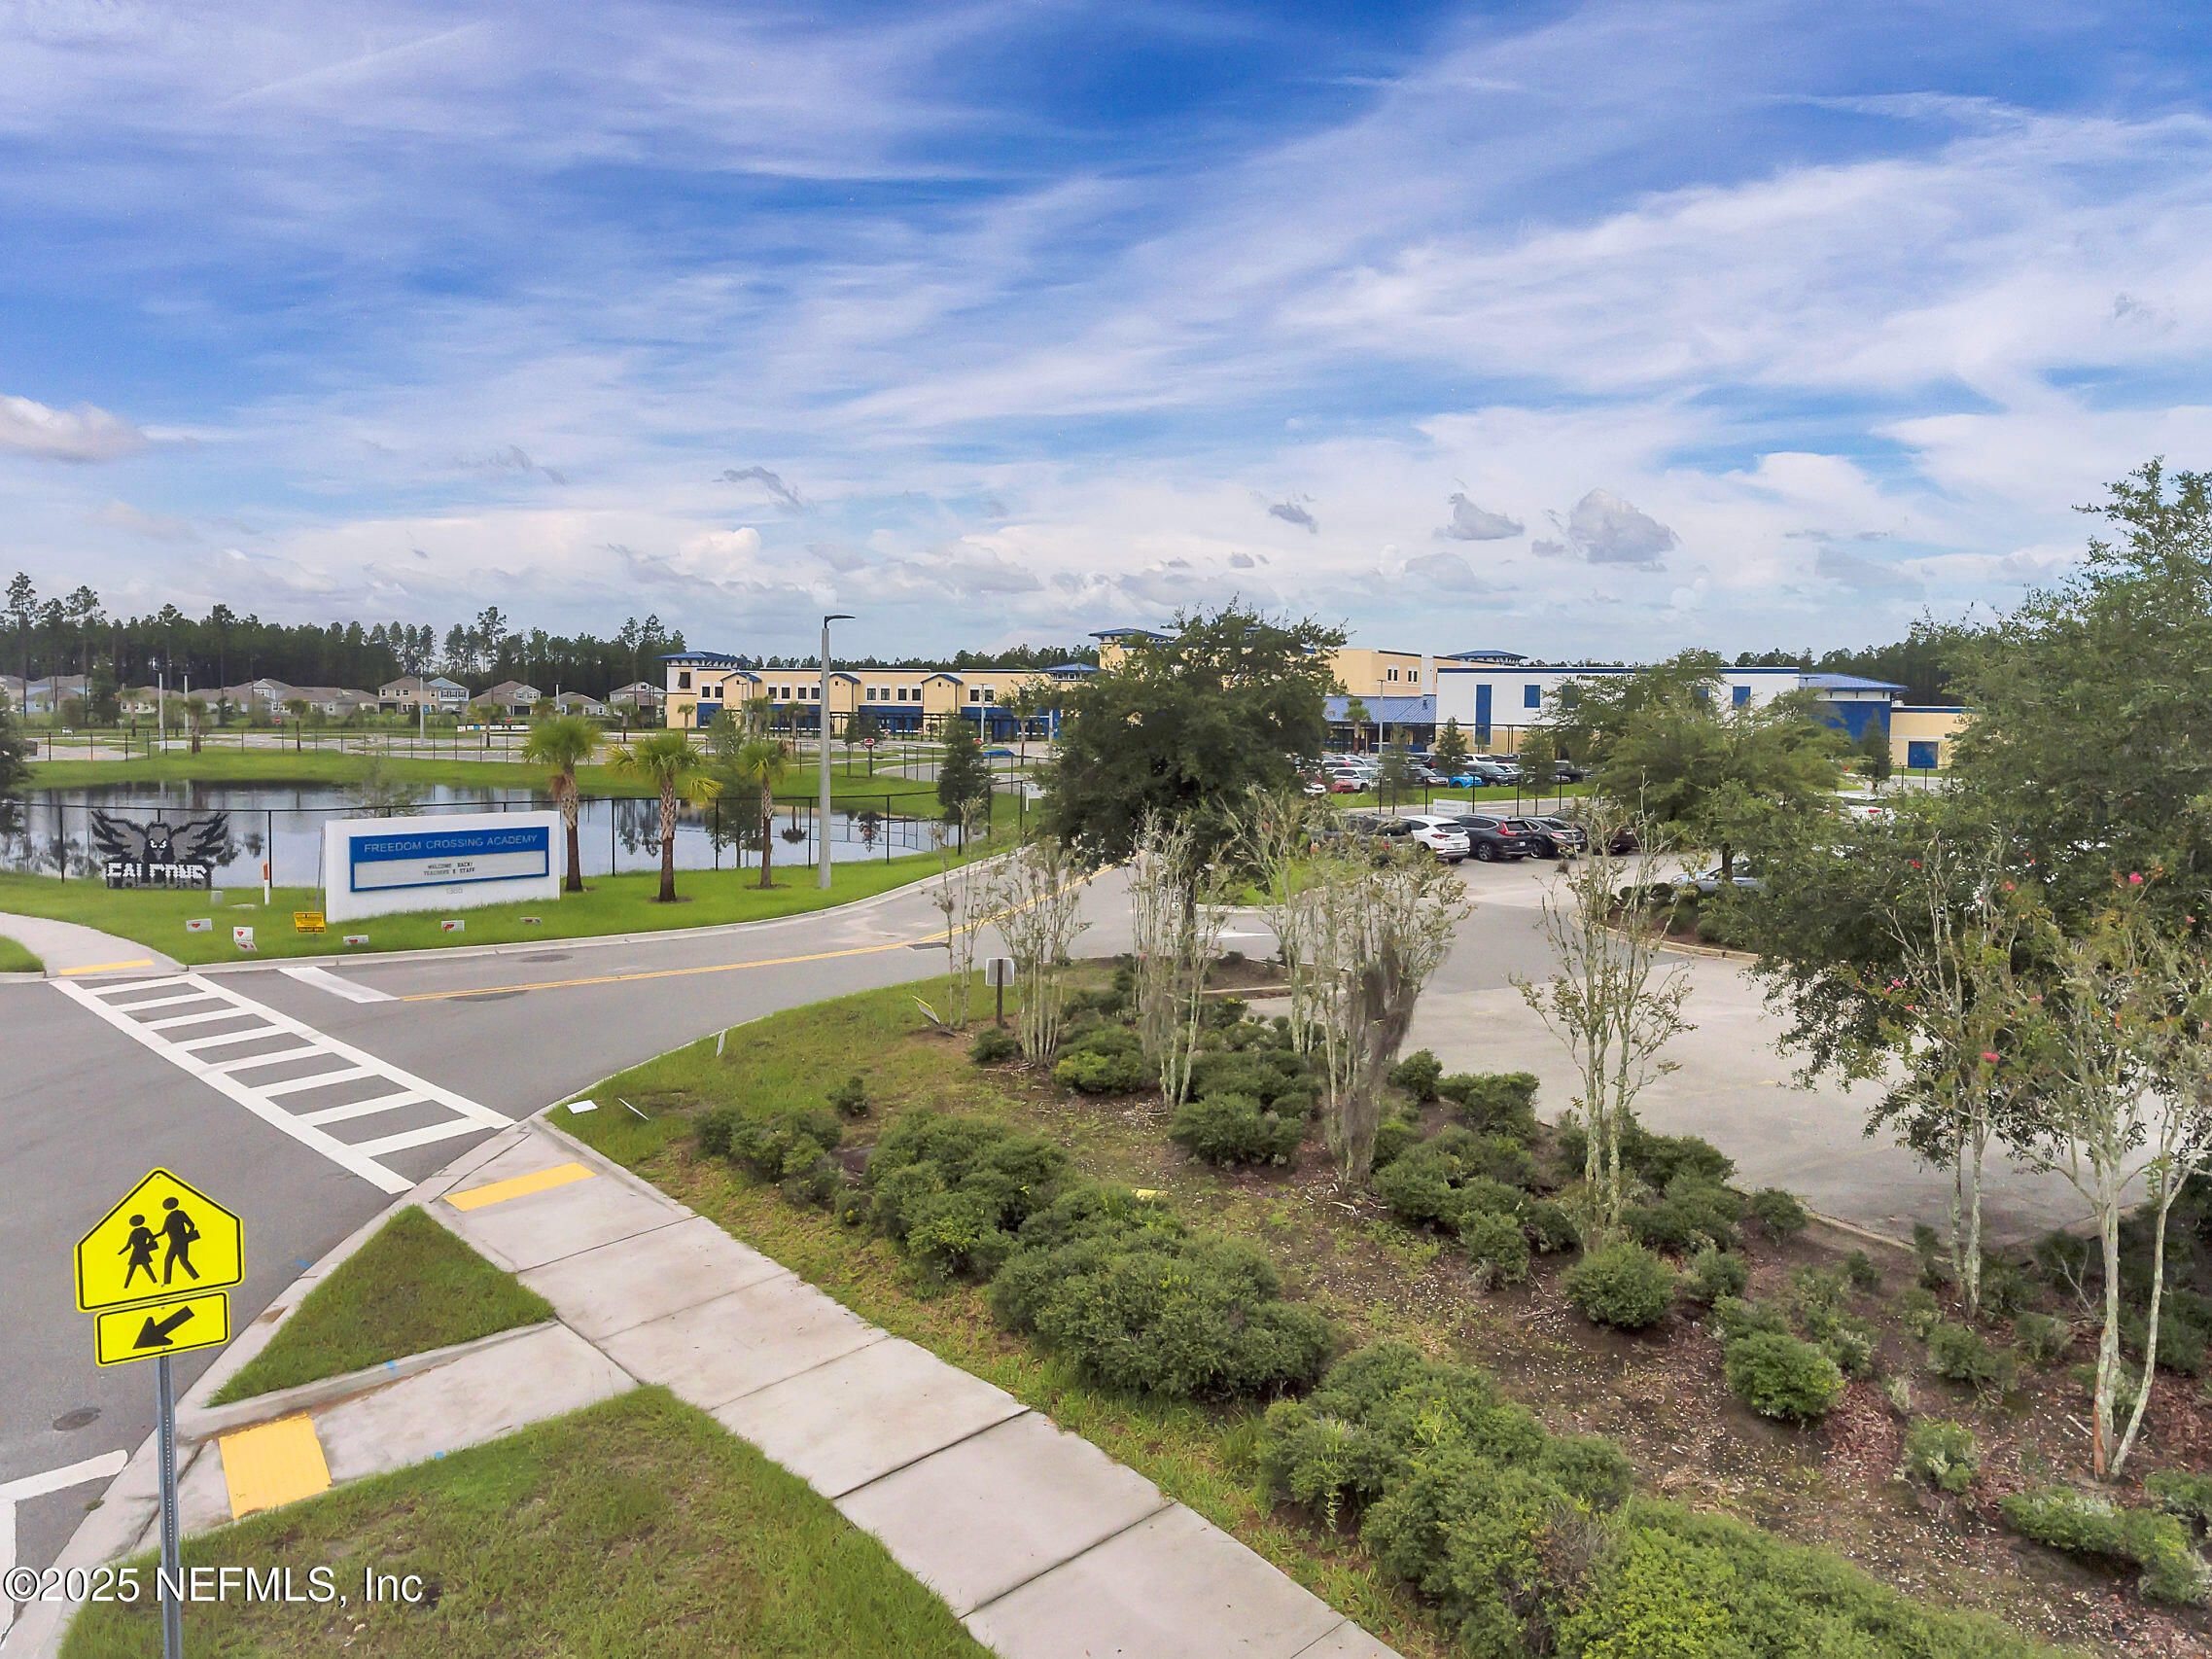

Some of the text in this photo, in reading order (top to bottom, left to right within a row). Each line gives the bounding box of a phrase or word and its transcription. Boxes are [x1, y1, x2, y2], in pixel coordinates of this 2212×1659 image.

[364, 834, 538, 853] FREEDOM CROSSING ACADEMY
